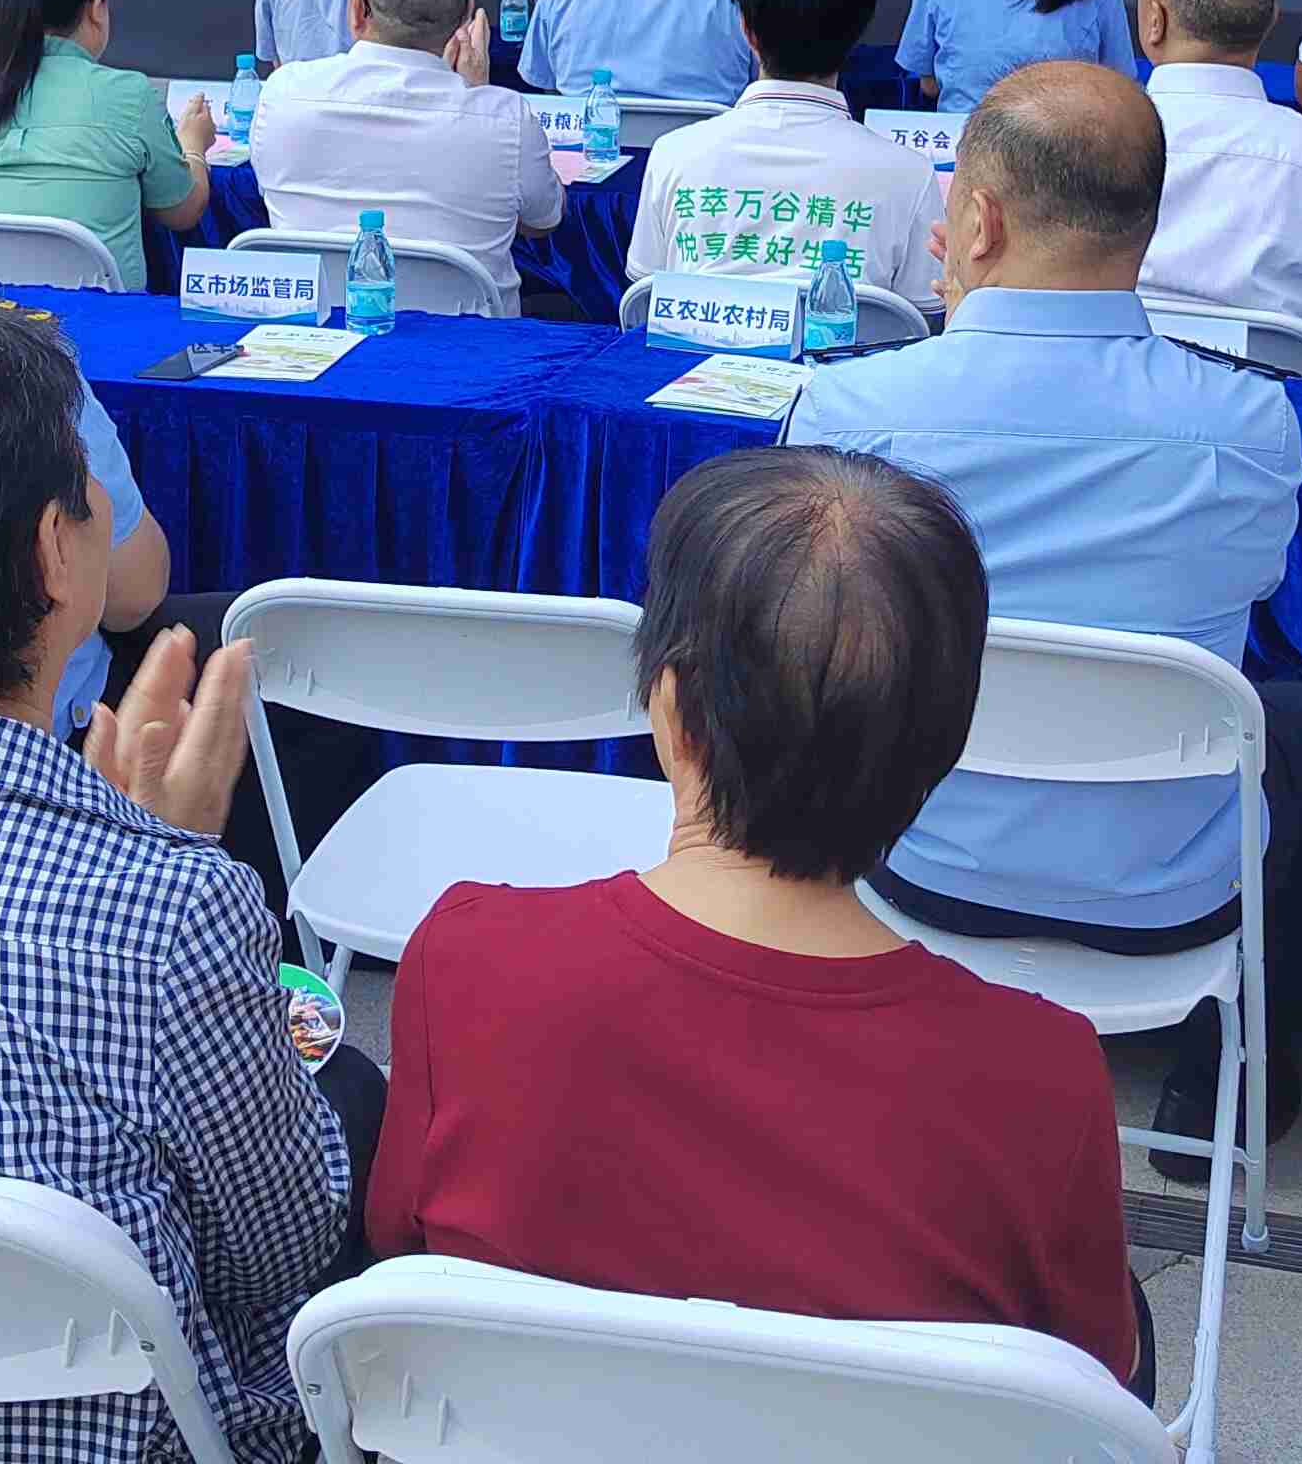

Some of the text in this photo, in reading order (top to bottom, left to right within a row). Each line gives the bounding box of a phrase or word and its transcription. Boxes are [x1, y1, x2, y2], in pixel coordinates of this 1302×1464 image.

[890, 129, 951, 149] 万谷会
[674, 186, 873, 234] 荟萃万谷精华
[185, 273, 315, 302] 区市场监管局
[654, 297, 791, 333] 区农业农村局
